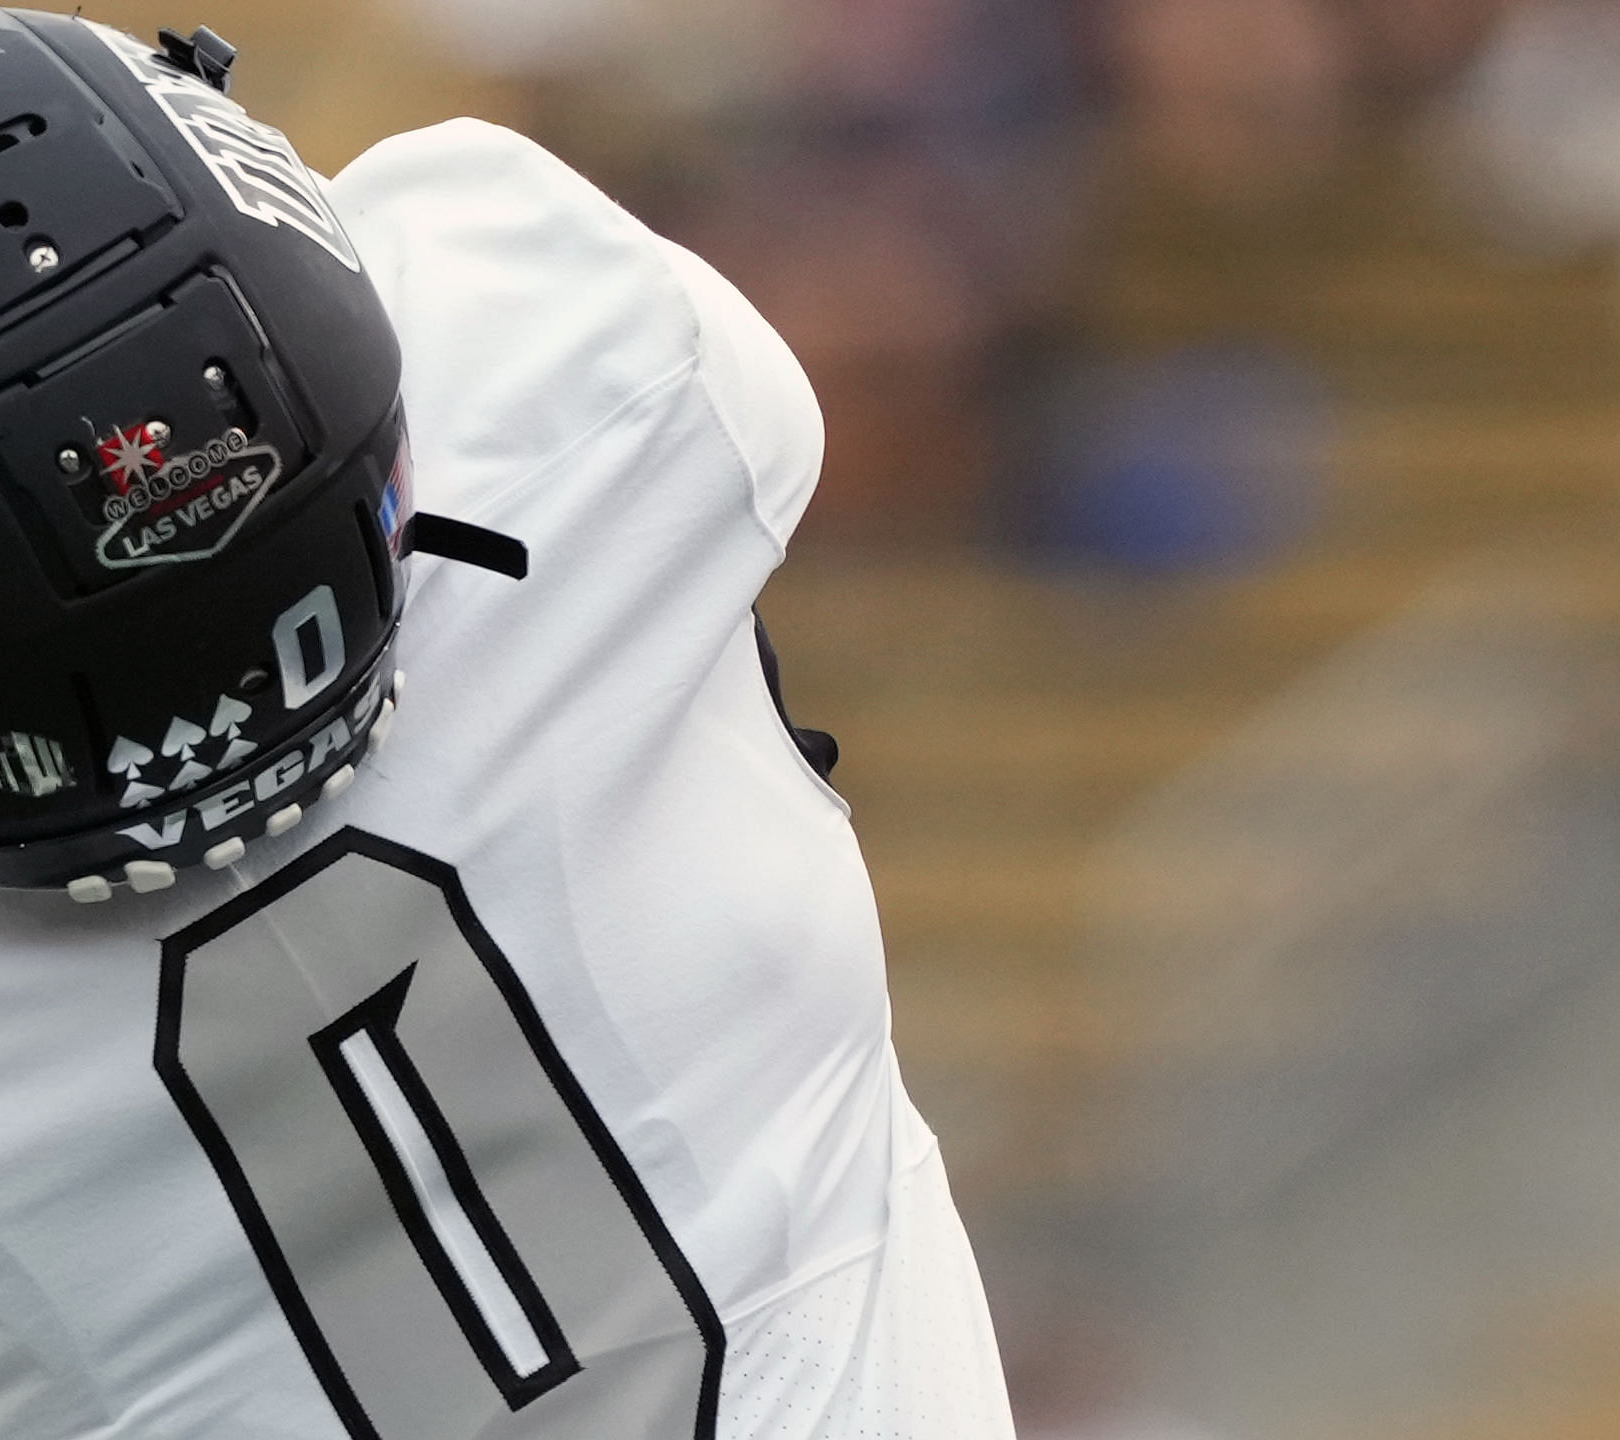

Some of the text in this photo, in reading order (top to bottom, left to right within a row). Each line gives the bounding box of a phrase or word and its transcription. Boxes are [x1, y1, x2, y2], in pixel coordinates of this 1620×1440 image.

[103, 427, 249, 522] WELCOME
[122, 516, 178, 557] LAS
[174, 466, 264, 528] VEGAS
[272, 584, 346, 710] 0
[115, 670, 382, 850] VEGAS
